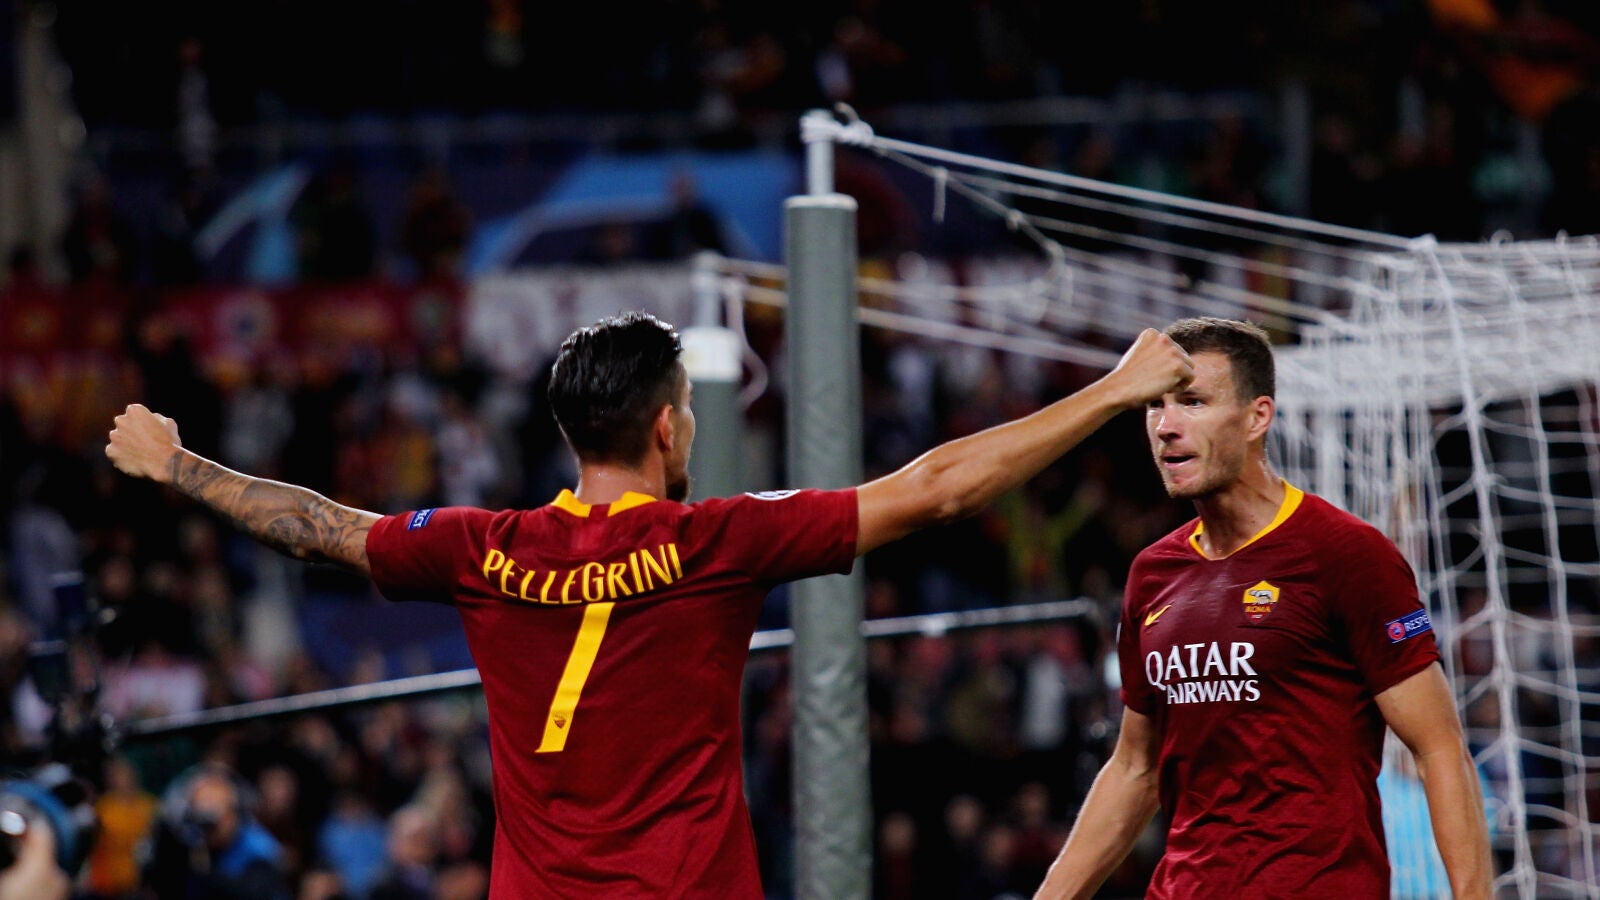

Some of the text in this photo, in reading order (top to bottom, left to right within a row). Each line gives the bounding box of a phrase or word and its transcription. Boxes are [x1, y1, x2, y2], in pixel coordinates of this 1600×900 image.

[483, 543, 683, 604] PELLEGRINI
[1145, 641, 1258, 691] QATAR
[1166, 679, 1261, 705] AIRWAYS
